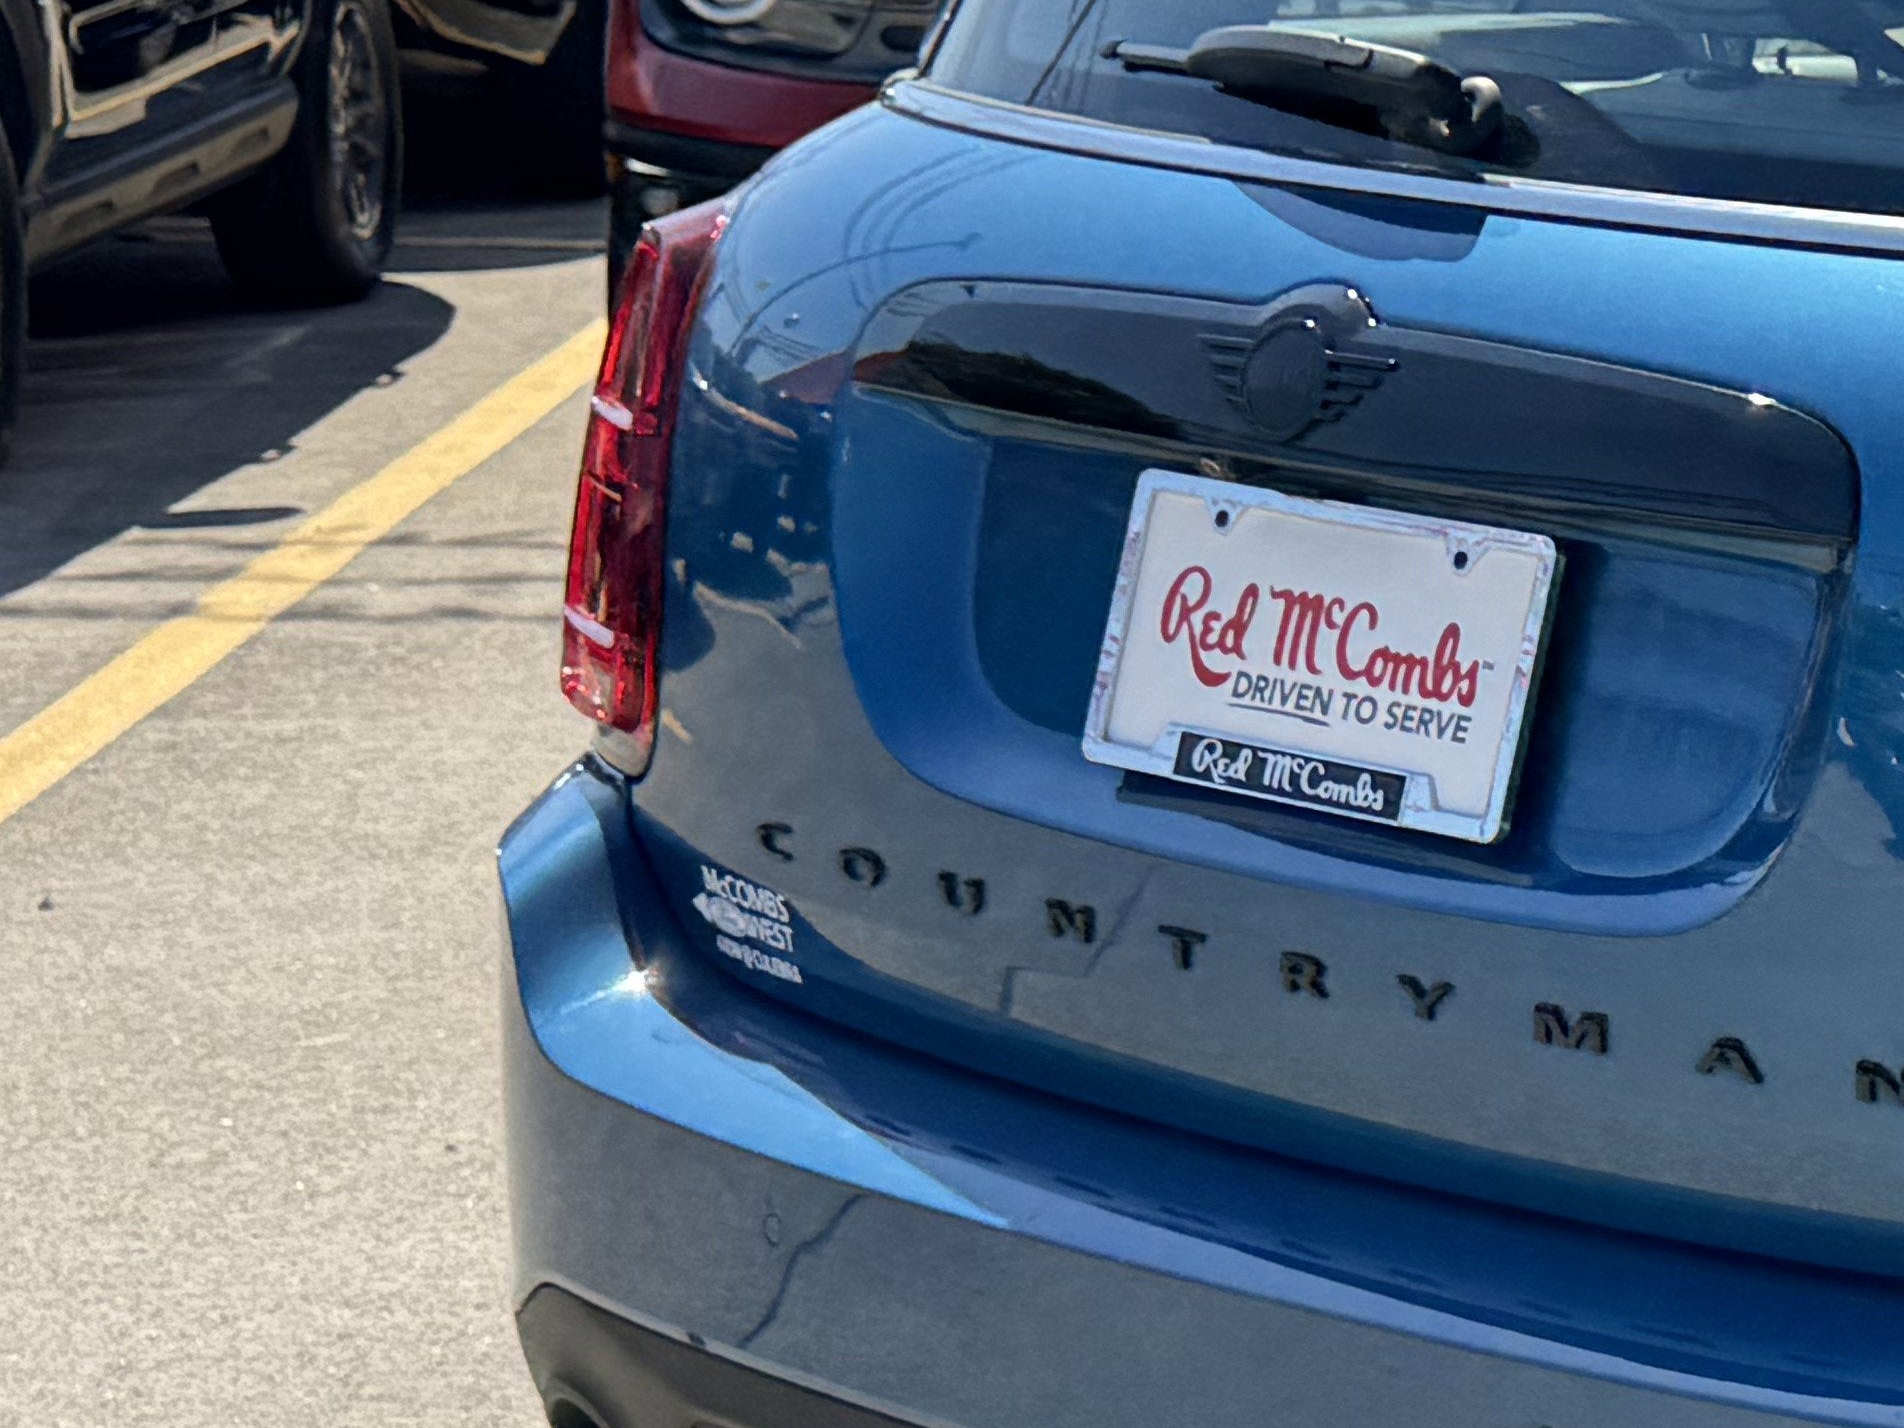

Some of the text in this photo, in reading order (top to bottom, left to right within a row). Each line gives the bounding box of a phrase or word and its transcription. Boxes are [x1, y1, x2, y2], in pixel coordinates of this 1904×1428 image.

[1161, 565, 1480, 708] Red McCombs
[1231, 671, 1473, 744] DRIVEN TO SERVE
[1192, 738, 1384, 812] Red McCombs
